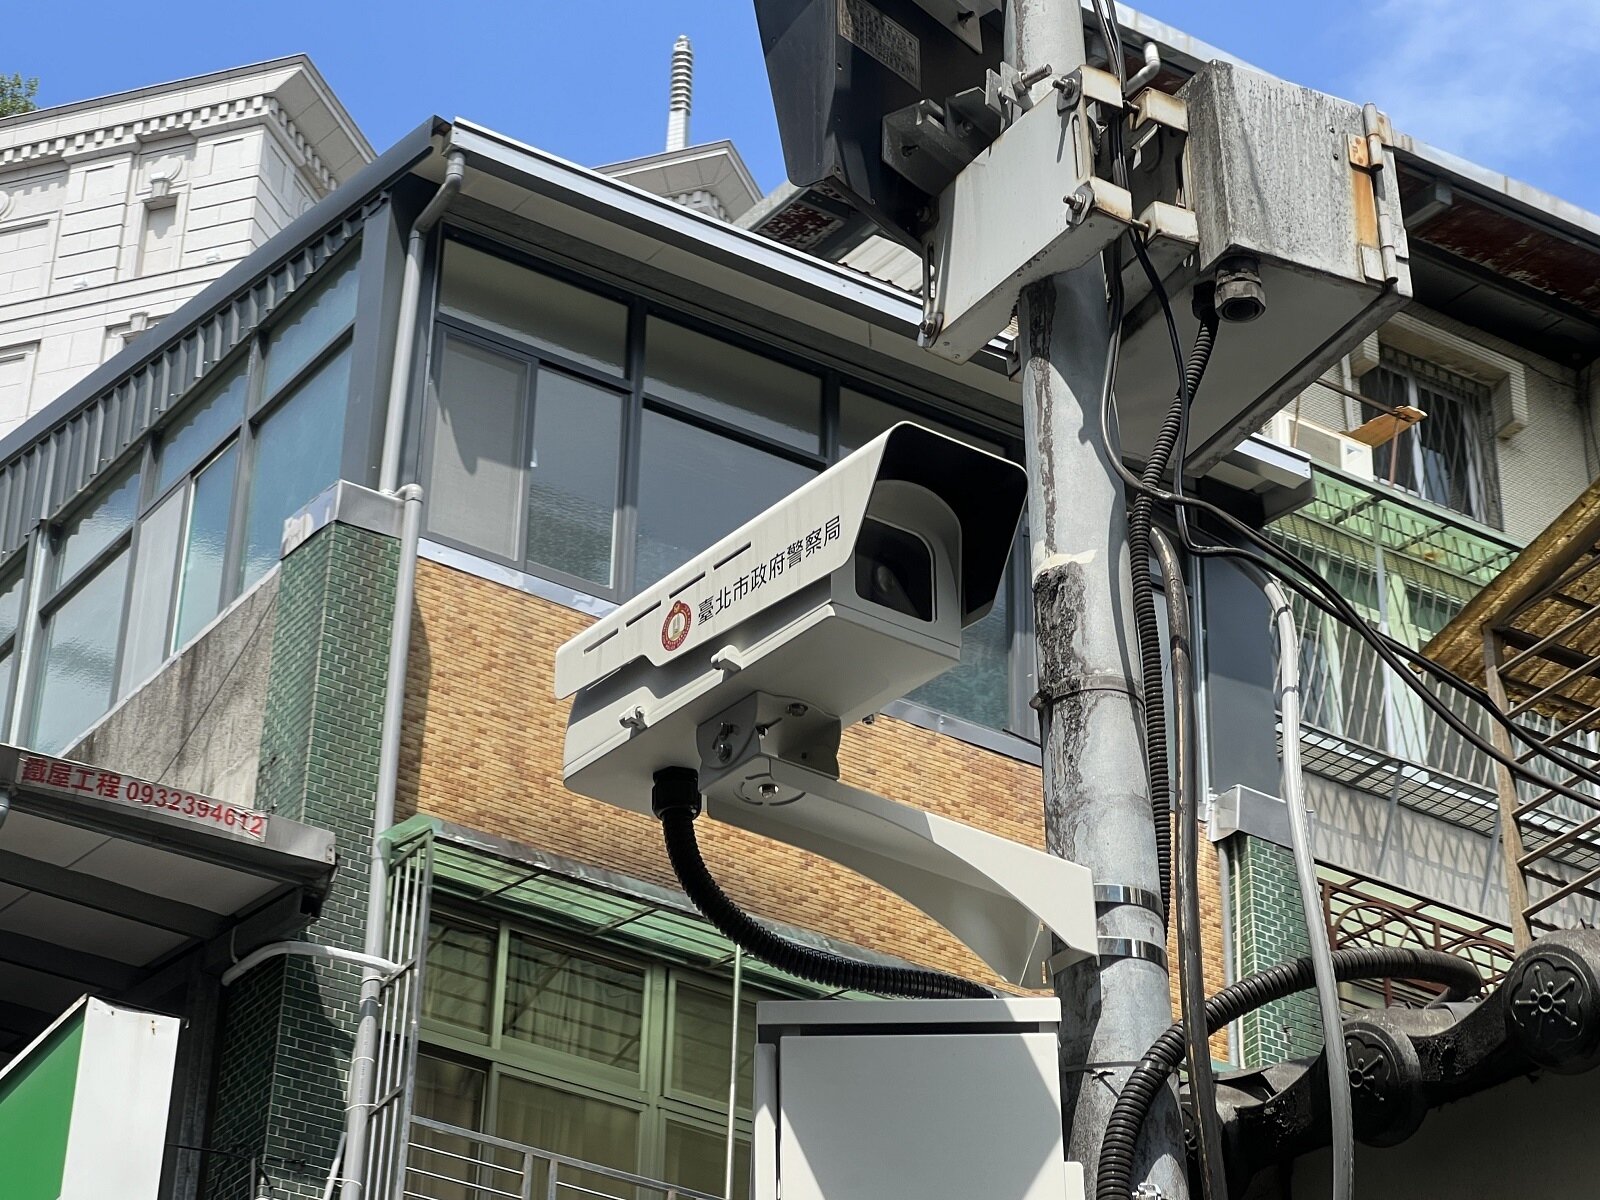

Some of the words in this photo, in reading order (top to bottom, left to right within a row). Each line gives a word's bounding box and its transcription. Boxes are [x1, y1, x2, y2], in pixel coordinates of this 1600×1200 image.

[698, 515, 840, 626] 臺北市政府警察局
[127, 782, 263, 835] 0932394612
